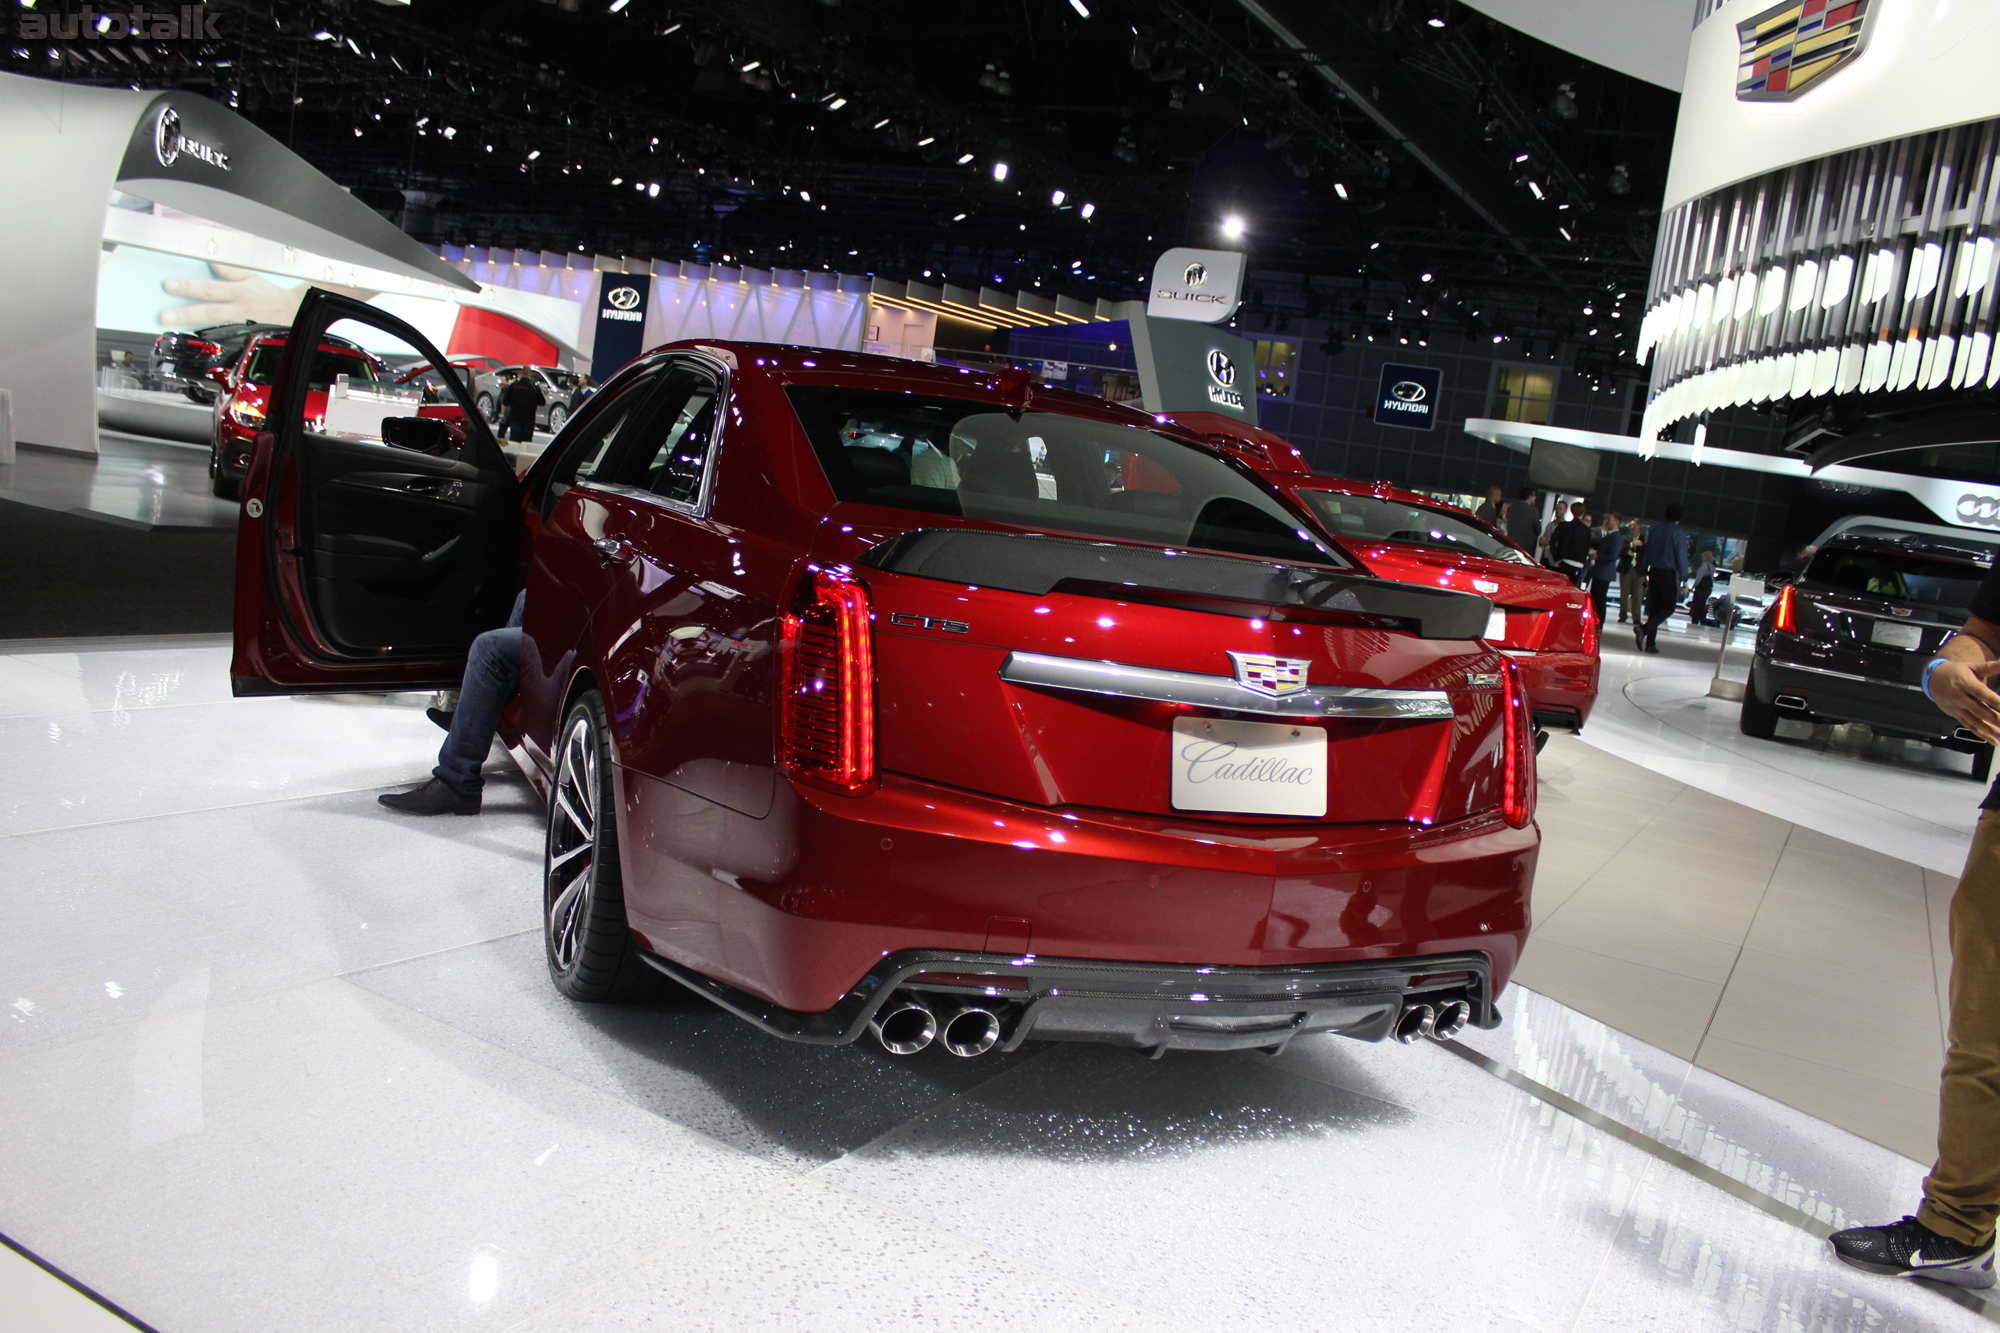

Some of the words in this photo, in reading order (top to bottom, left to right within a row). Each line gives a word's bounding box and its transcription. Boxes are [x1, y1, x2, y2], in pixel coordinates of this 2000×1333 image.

[1157, 290, 1228, 305] BUICK
[602, 308, 643, 322] HYUNDAI
[1383, 399, 1429, 414] HYUNDAI
[890, 612, 970, 634] CTS
[1181, 741, 1313, 785] Cadillac
